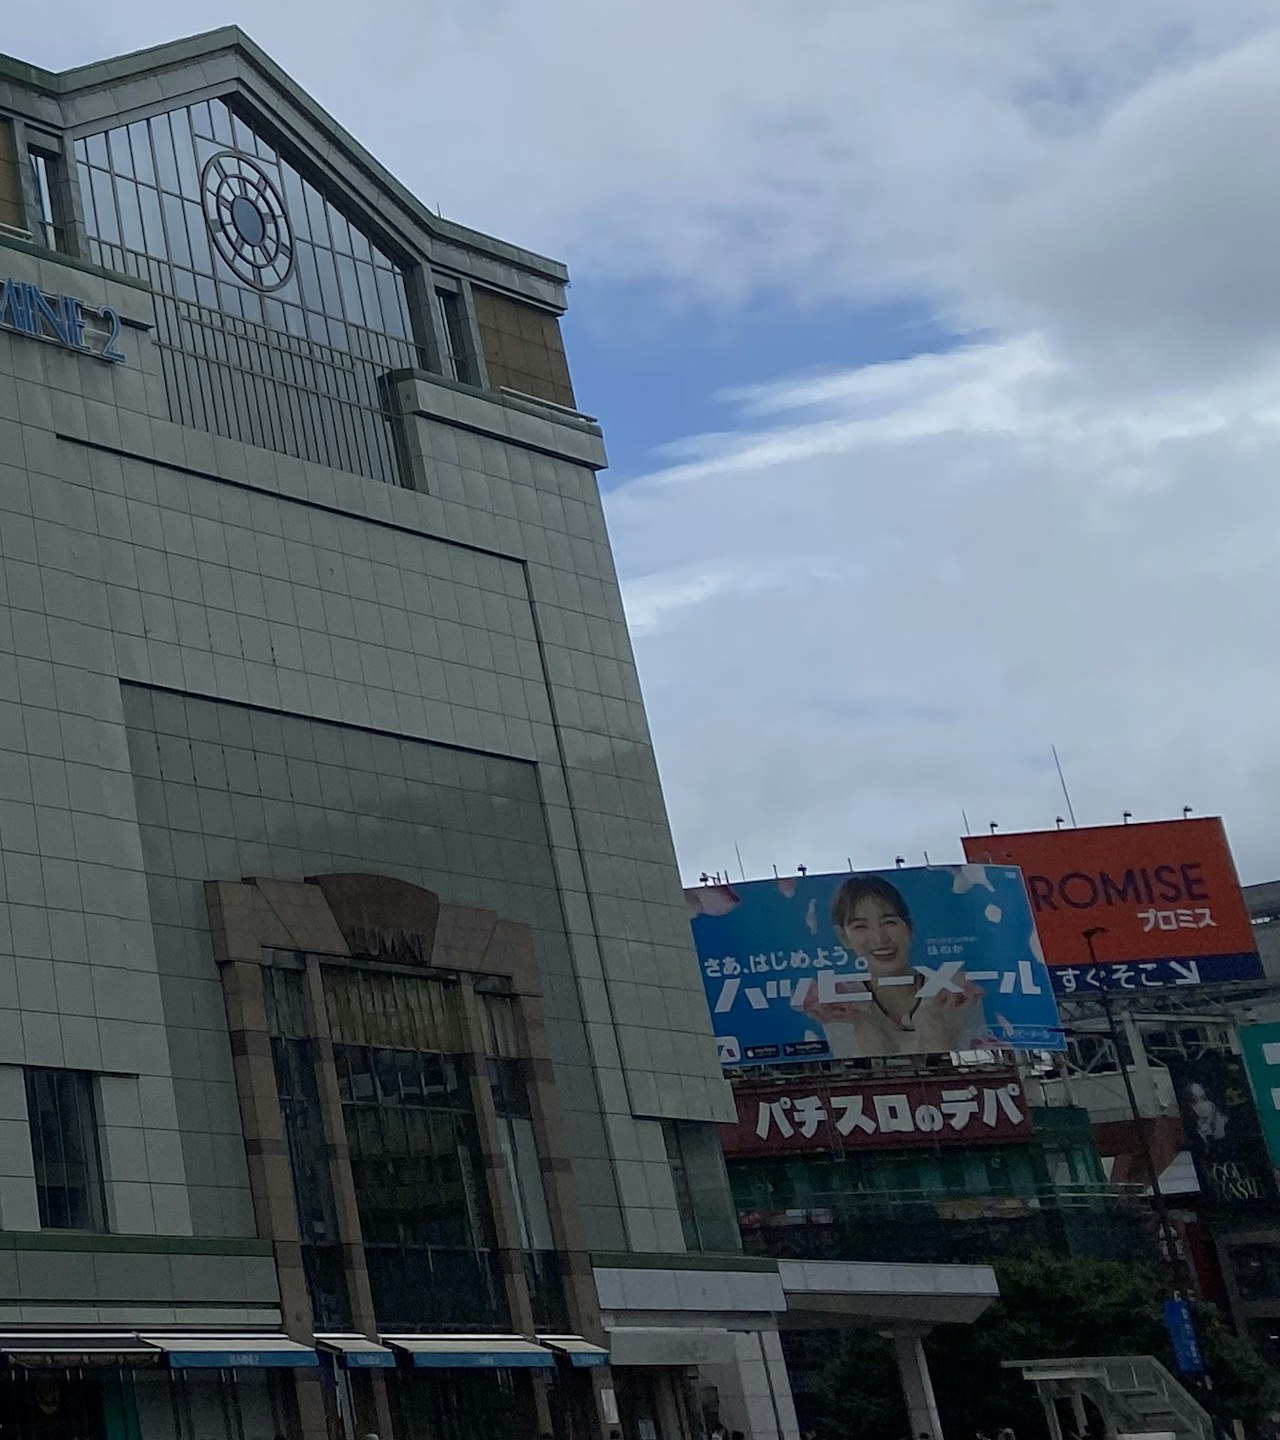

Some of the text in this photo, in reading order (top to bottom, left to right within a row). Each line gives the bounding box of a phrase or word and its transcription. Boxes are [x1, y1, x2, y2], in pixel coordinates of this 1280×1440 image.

[99, 305, 128, 364] 2
[1028, 862, 1209, 912] ROMISE
[1137, 908, 1218, 932] プロミス
[714, 957, 1041, 1013] ハッピーメール
[755, 1083, 1025, 1140] パチスロのデパ
